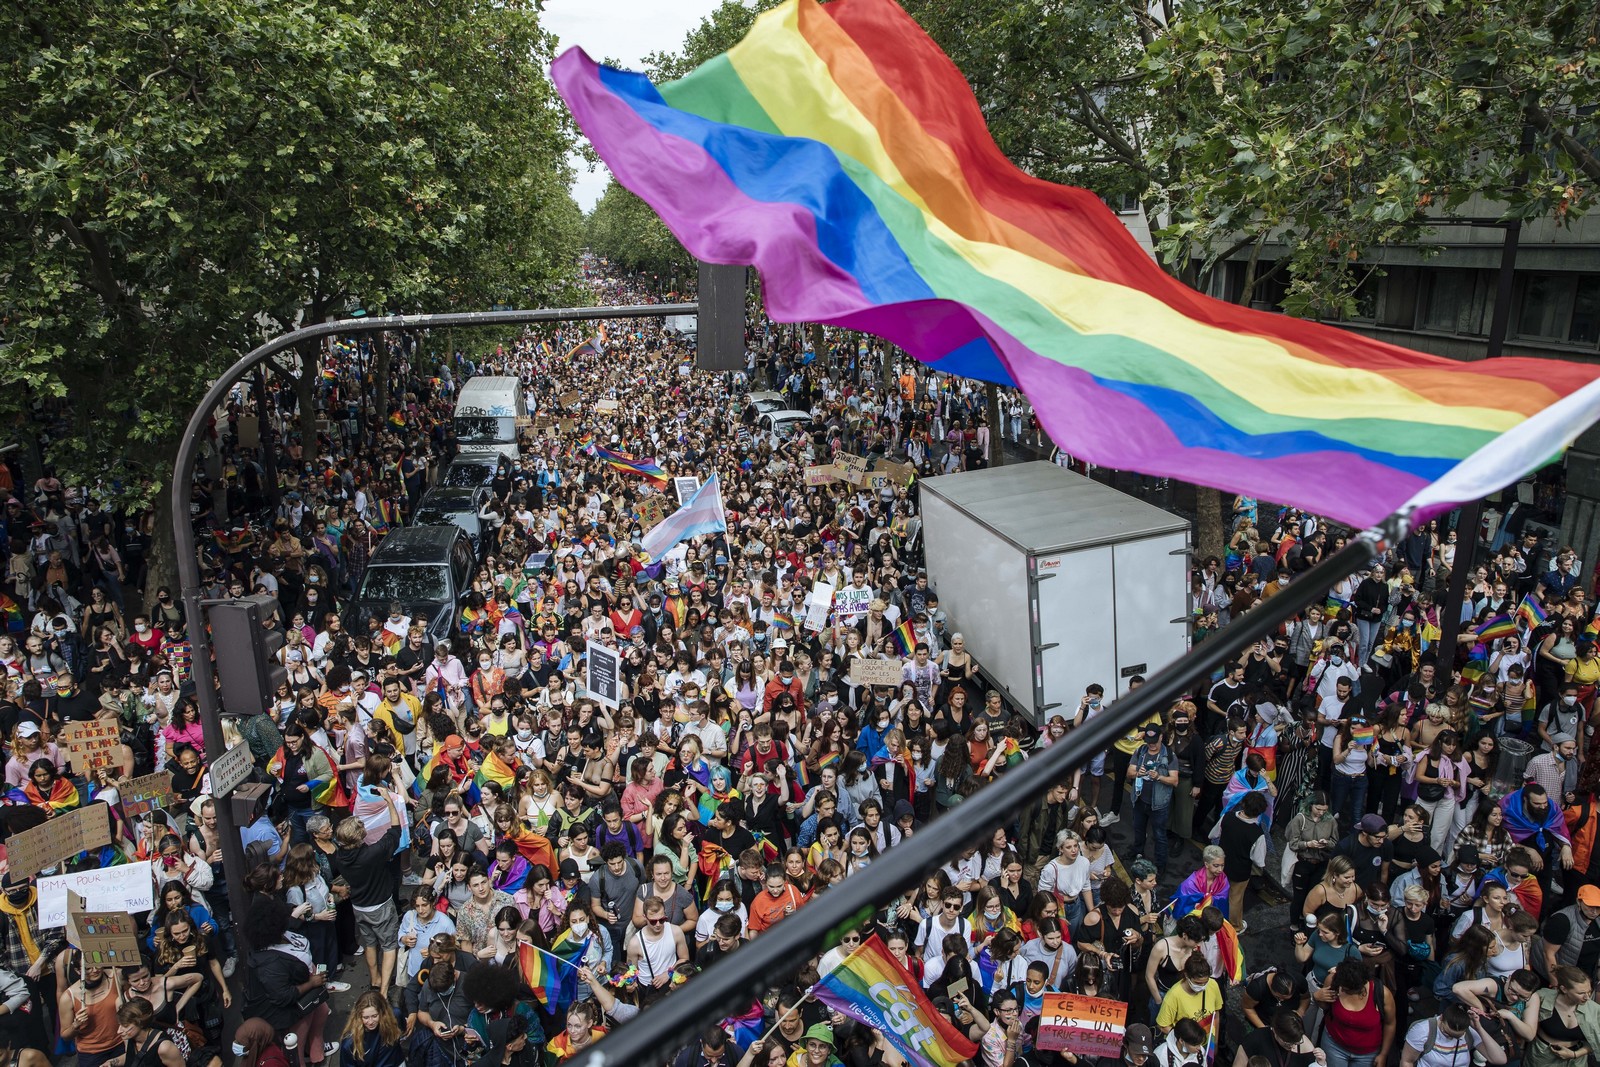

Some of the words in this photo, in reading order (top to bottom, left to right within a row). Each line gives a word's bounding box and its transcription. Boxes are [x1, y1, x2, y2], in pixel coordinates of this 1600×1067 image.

[836, 591, 848, 600] NOS
[849, 590, 869, 600] LUTTES
[835, 603, 849, 613] PAS
[70, 744, 82, 753] LES
[86, 737, 119, 750] FLAMMES
[82, 755, 115, 770] AMOUR
[220, 756, 246, 781] ATTENTION
[217, 780, 230, 793] FEUX
[122, 785, 171, 807] LUCKY
[124, 792, 175, 818] MOTHER
[41, 880, 68, 893] PMA
[76, 874, 101, 886] POUR
[101, 884, 126, 895] SANS
[47, 911, 66, 923] NOS
[124, 896, 150, 908] TRANS
[80, 924, 133, 935] COUPABLE
[84, 949, 141, 964] COMPLICE
[863, 1005, 882, 1026] Union
[1057, 1000, 1074, 1012] CE
[1089, 1004, 1122, 1019] N'EST
[1054, 1014, 1080, 1028] PAS
[1093, 1020, 1113, 1033] UN
[1080, 1031, 1095, 1043] DE
